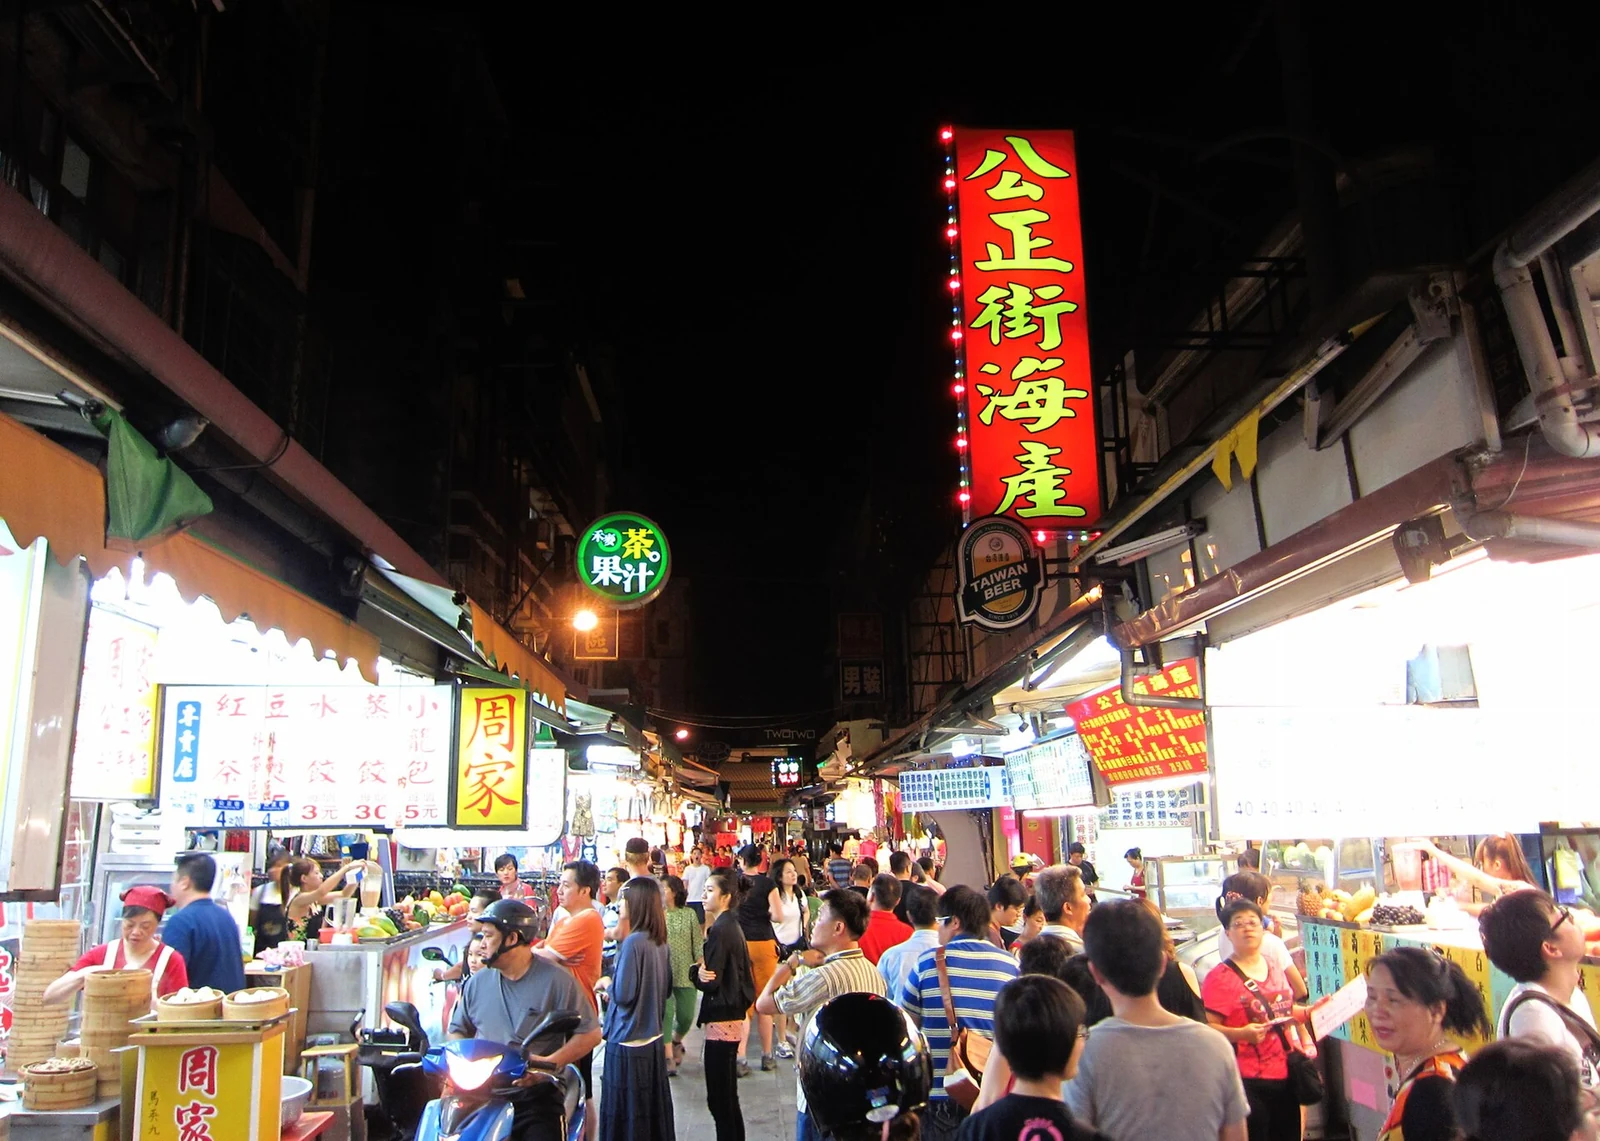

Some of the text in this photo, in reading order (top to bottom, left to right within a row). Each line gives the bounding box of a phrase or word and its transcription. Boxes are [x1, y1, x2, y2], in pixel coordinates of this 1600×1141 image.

[964, 136, 1088, 519] 公正街海產
[622, 528, 655, 559] 茶
[591, 555, 655, 593] 果汁
[970, 563, 1028, 593] TAIWAN
[984, 578, 1022, 601] BEER
[843, 665, 881, 696] 男裝
[463, 693, 520, 818] 周家
[301, 804, 338, 820] 3元
[405, 804, 438, 819] 5元
